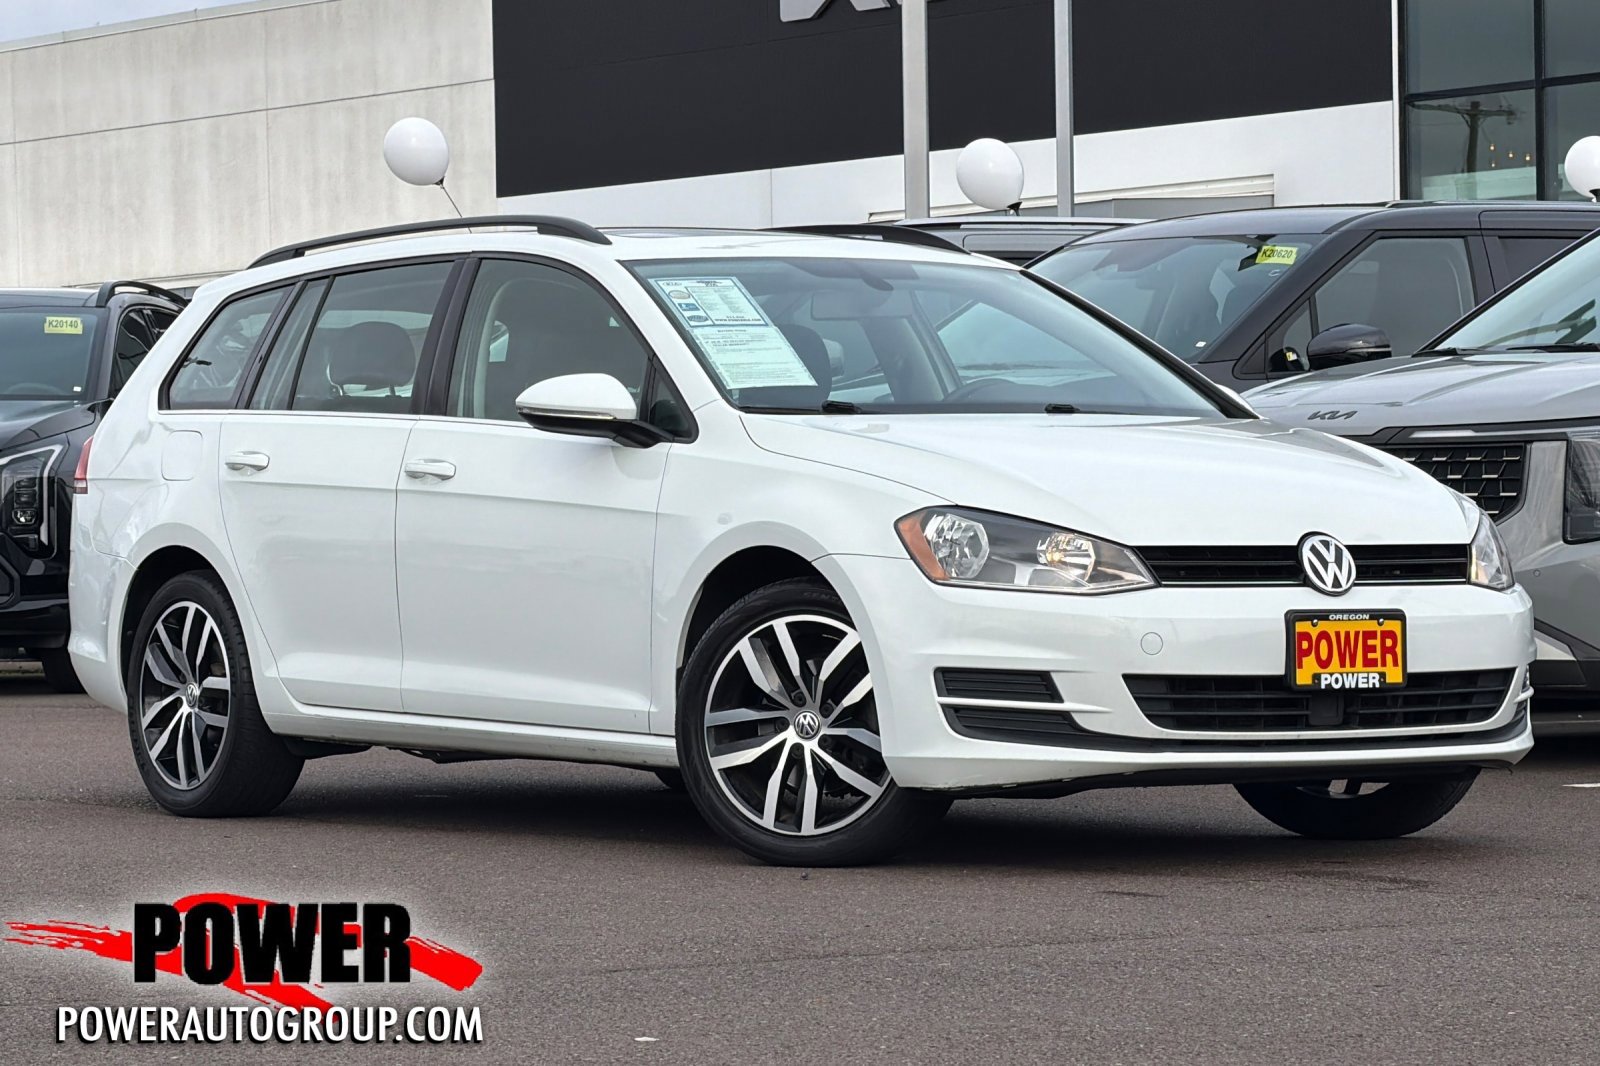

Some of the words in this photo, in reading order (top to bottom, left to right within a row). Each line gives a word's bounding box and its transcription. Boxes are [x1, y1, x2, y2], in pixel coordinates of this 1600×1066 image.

[1260, 248, 1294, 259] K20620
[47, 319, 79, 329] K20140
[1328, 613, 1370, 621] OREGON
[1296, 629, 1399, 670] POWER
[1320, 672, 1380, 690] POWER
